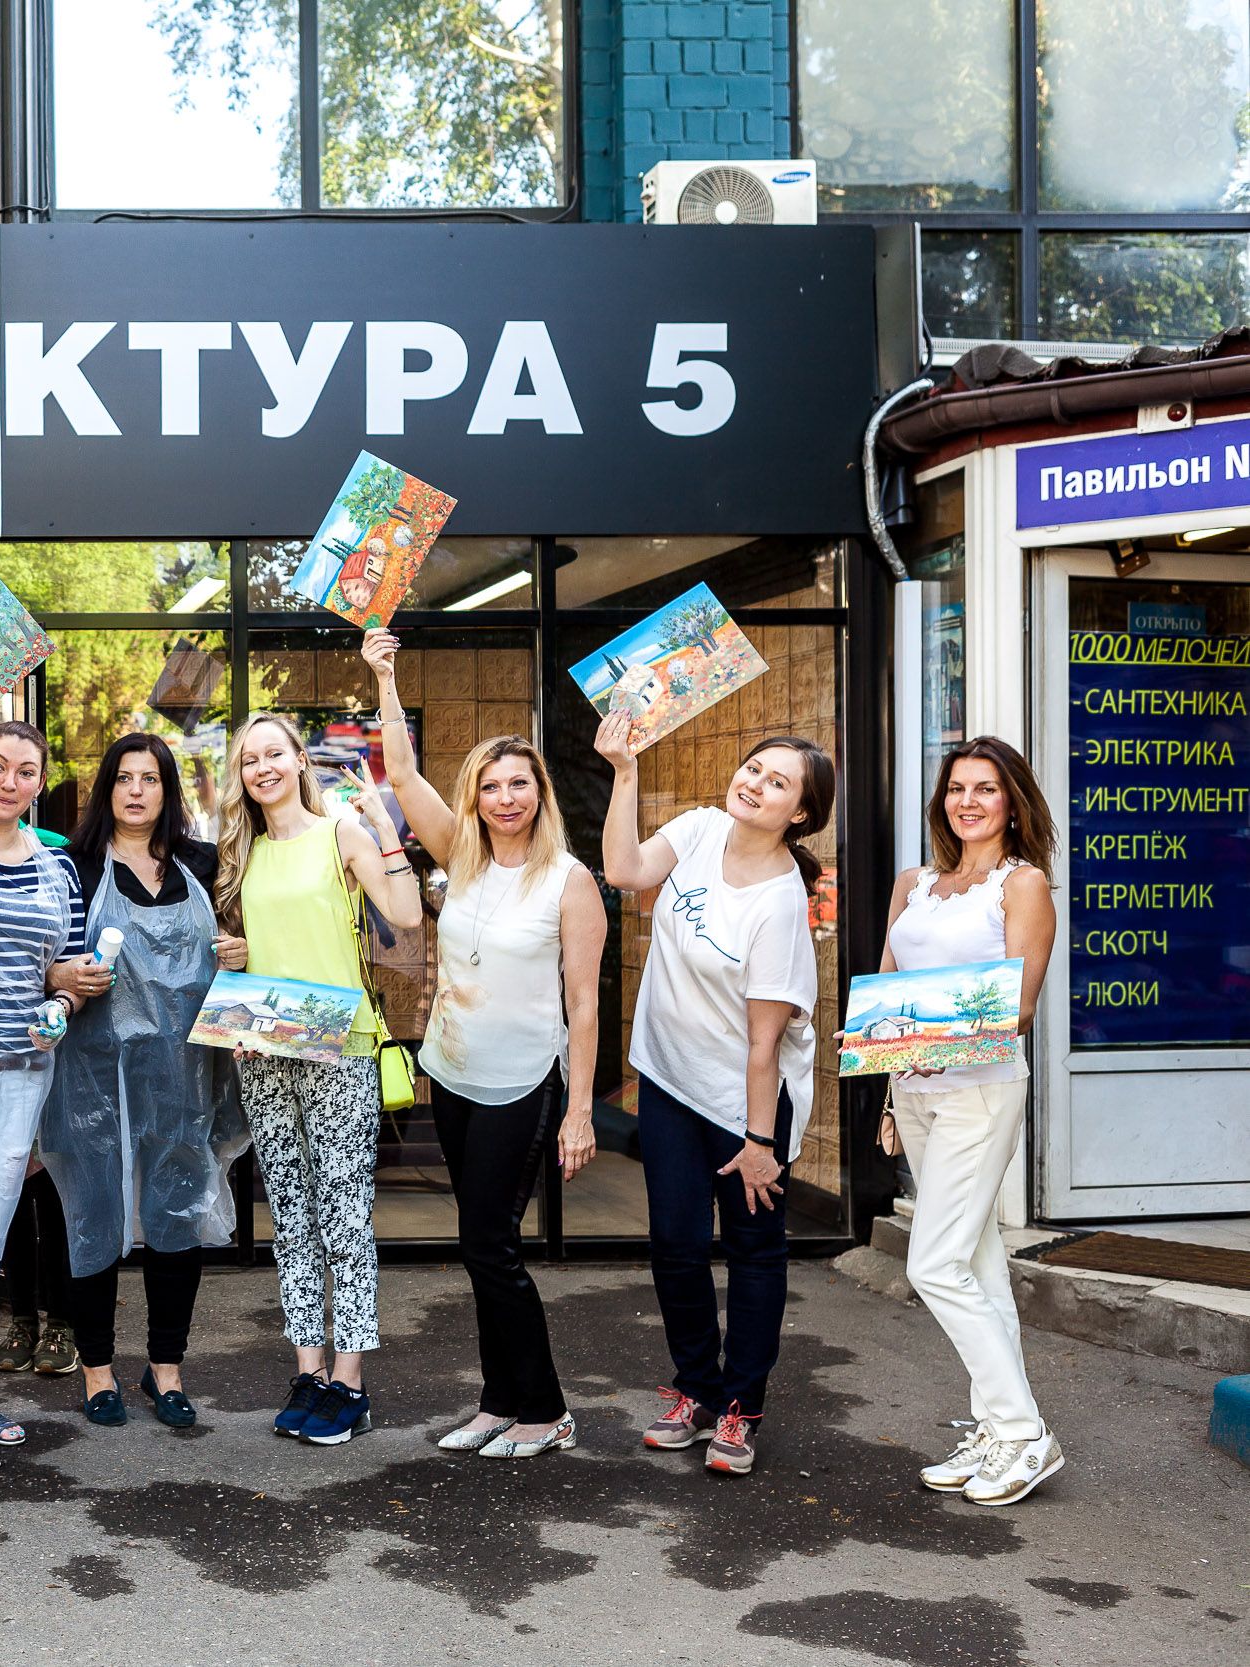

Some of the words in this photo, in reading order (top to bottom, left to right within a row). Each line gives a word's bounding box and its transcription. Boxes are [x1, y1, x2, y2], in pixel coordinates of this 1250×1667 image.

[642, 322, 737, 438] 5
[1039, 454, 1211, 502] Павильон
[1135, 615, 1201, 631] ОТКРЫТО
[1070, 632, 1131, 662] 1000
[1133, 635, 1250, 665] МЕЛОЧЕЙ
